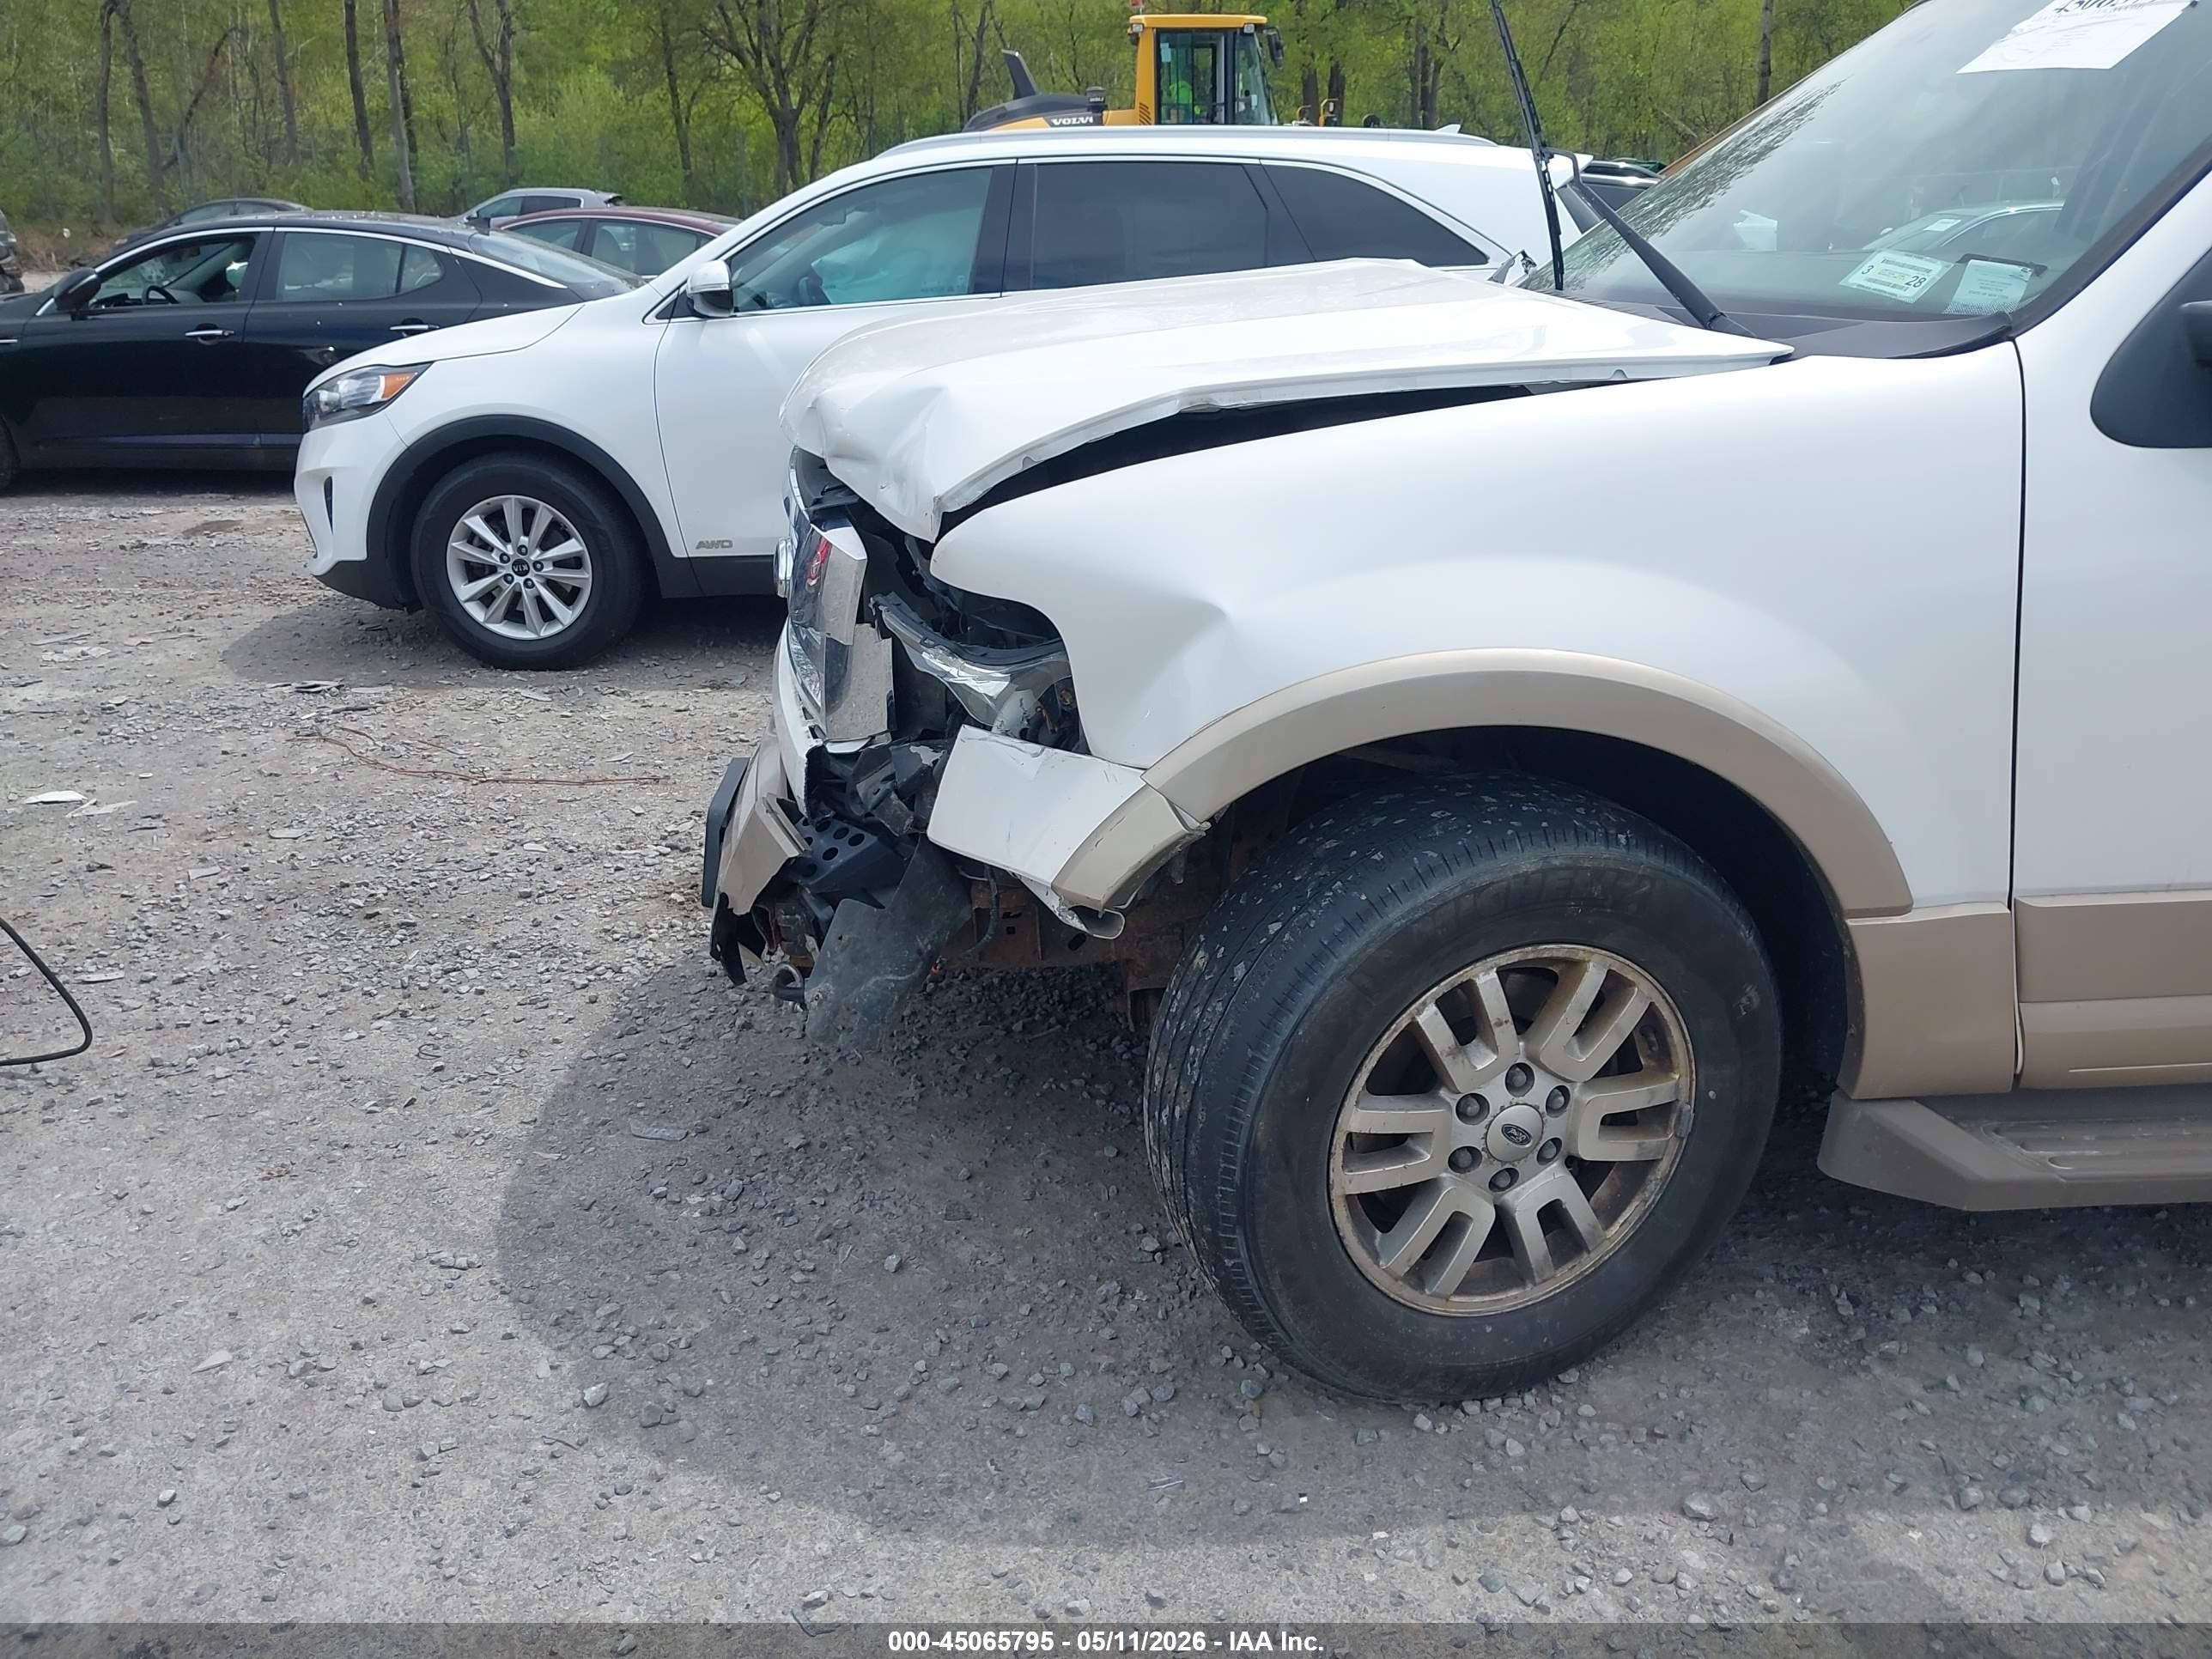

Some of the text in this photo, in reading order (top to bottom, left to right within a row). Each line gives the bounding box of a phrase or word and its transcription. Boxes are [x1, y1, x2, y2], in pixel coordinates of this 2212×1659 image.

[1861, 264, 1875, 275] 3
[1905, 275, 1927, 288] 28
[696, 539, 733, 550] AWD
[513, 563, 529, 572] KIA
[1505, 1127, 1528, 1143] Ford
